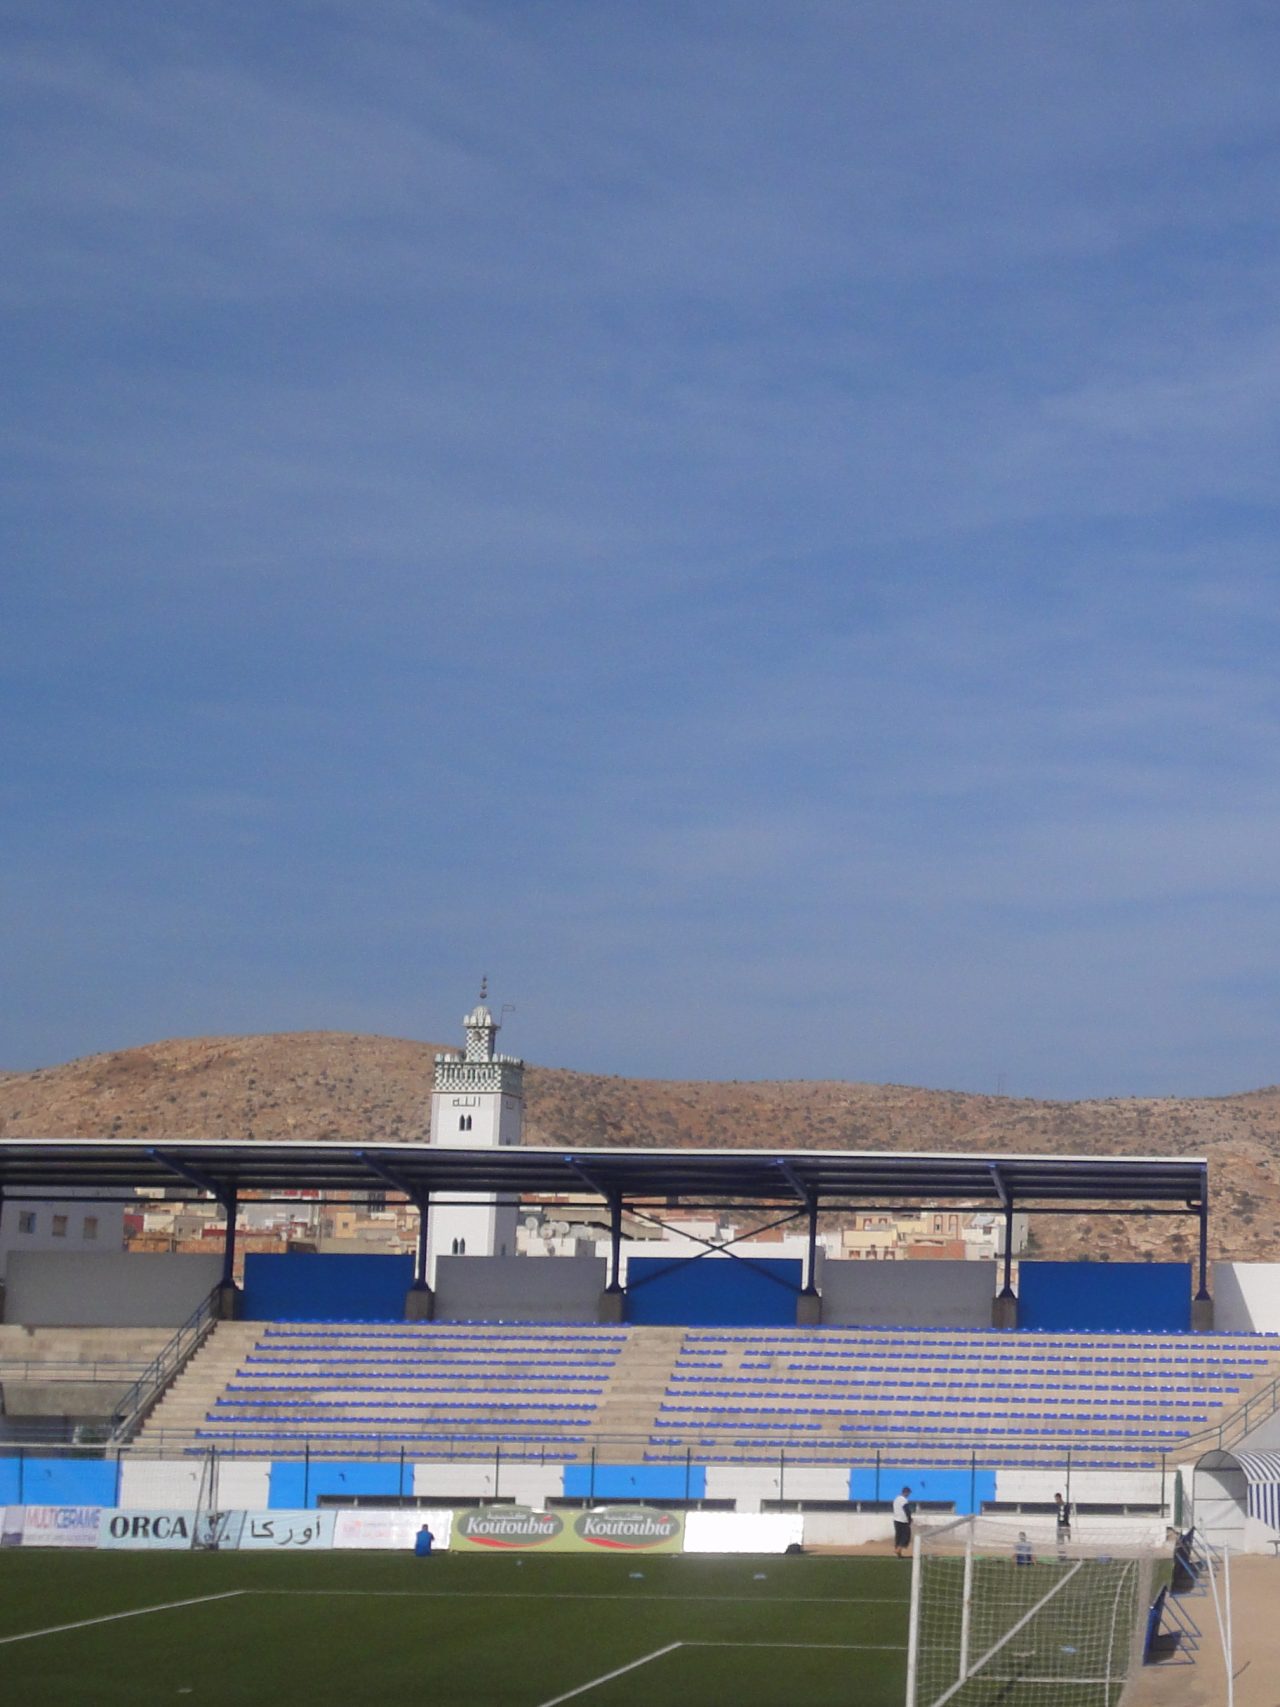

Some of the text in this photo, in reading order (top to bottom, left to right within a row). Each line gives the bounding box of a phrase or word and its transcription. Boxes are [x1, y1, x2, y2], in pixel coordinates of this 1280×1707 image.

[110, 1516, 188, 1539] ORCA
[251, 1514, 321, 1545] أوركا
[466, 1516, 554, 1535] Koutoubia
[583, 1517, 671, 1536] Koutoubia
